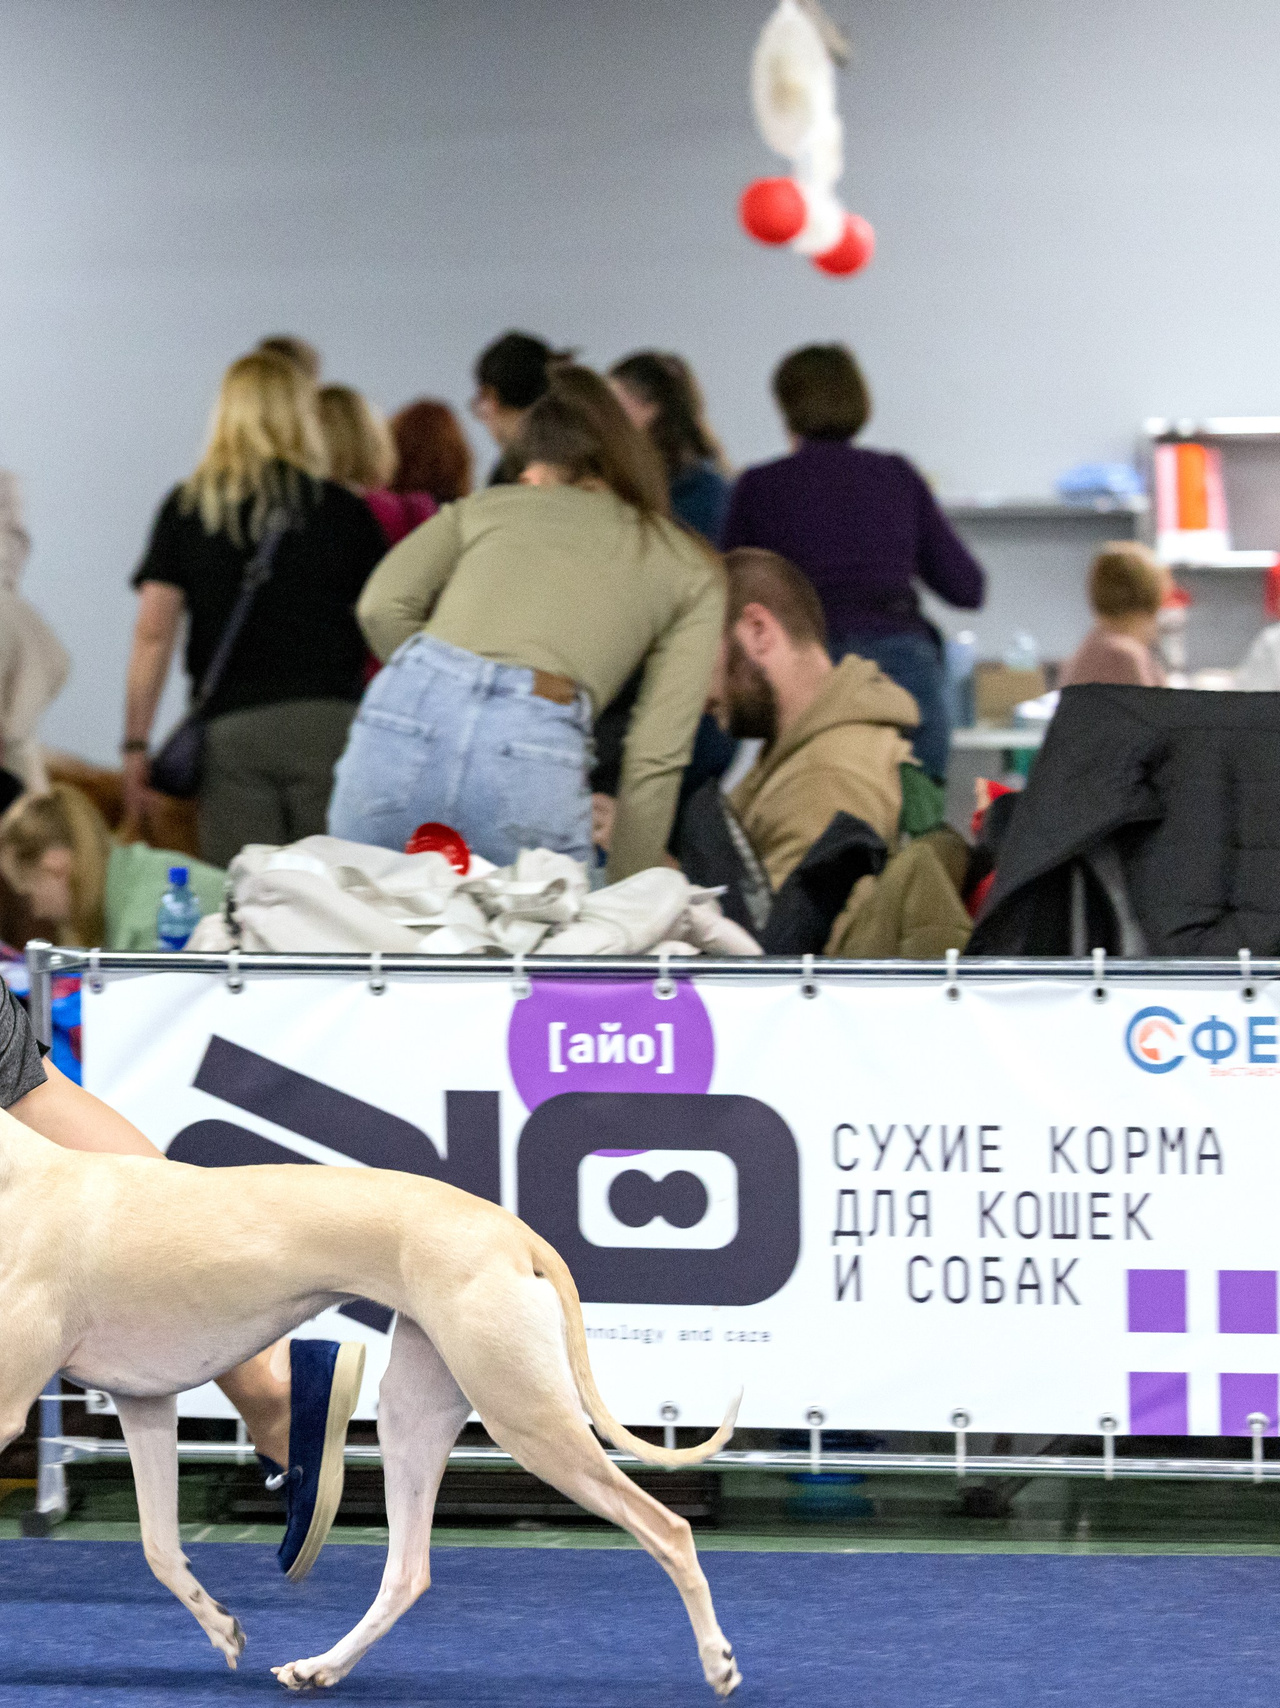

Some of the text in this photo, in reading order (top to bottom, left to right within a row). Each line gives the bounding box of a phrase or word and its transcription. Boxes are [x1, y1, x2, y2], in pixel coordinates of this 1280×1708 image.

[1126, 1005, 1278, 1074] СФЕ
[833, 1122, 1223, 1175] СУХИЕ КОРМА
[831, 1188, 1152, 1247] ДЛЯ КОШЕК
[834, 1254, 1081, 1306] И СОБАК
[584, 1324, 664, 1344] hnology
[678, 1328, 713, 1342] and
